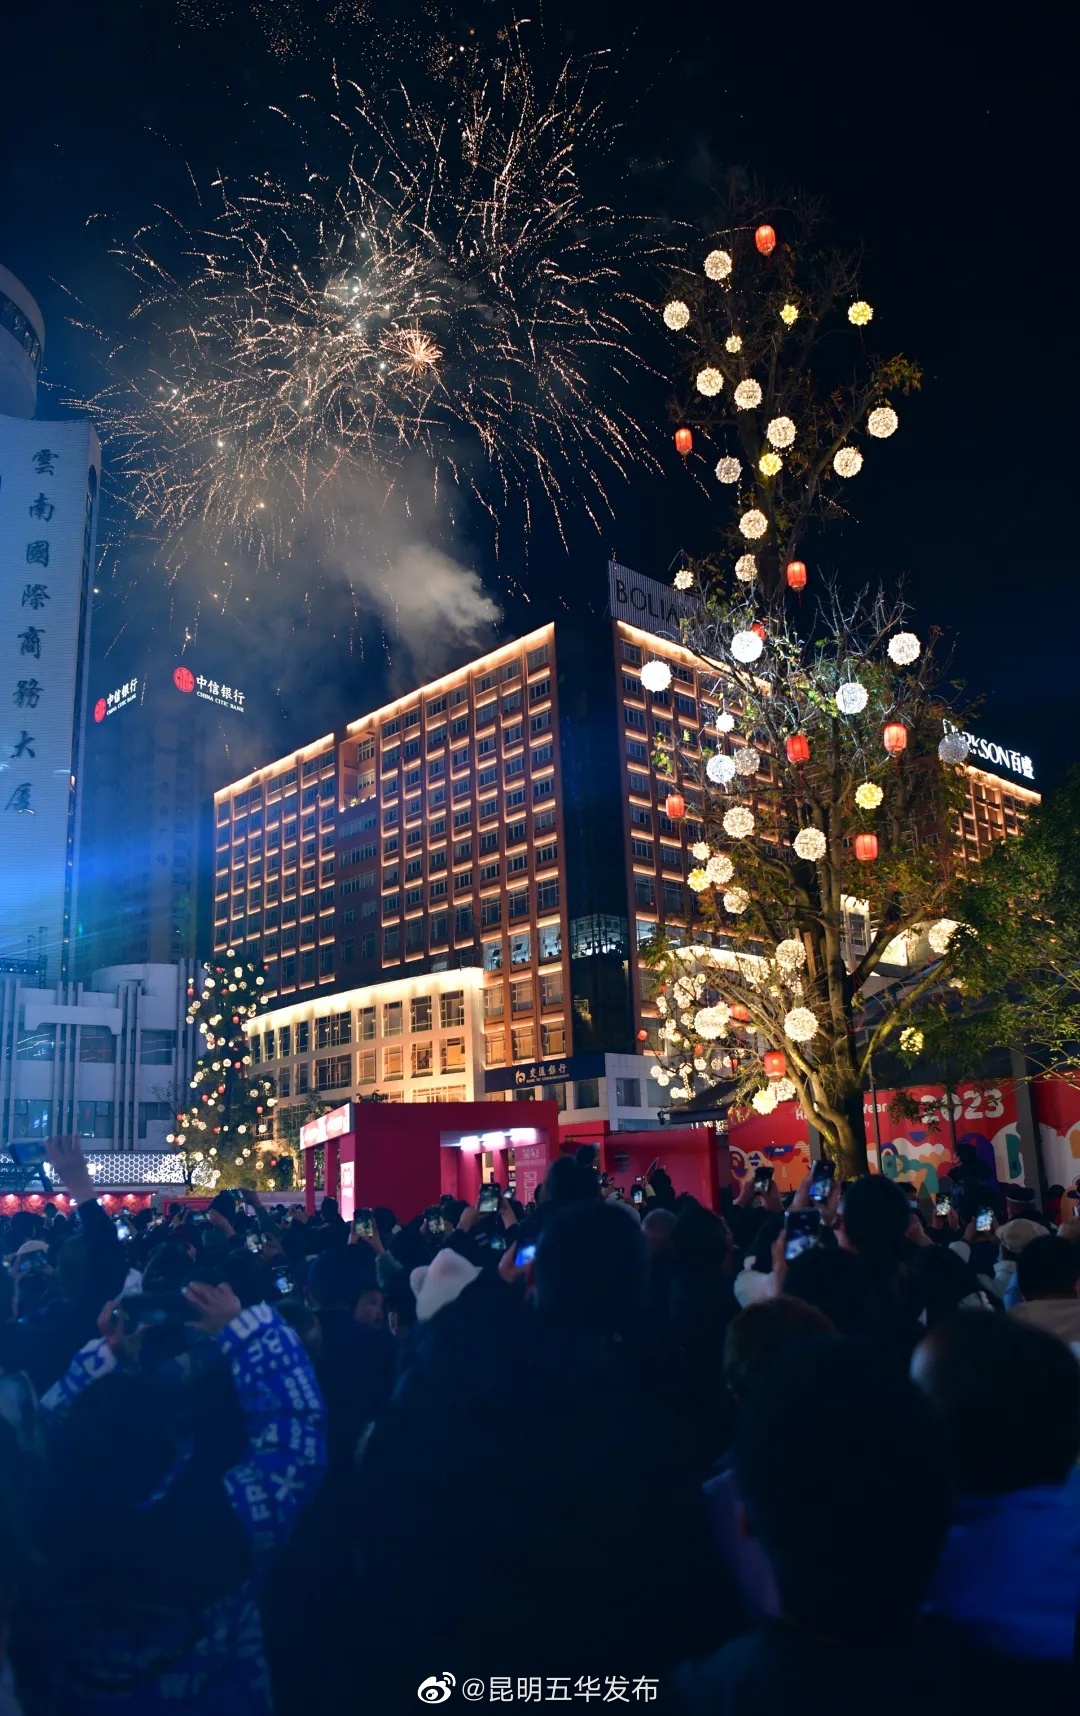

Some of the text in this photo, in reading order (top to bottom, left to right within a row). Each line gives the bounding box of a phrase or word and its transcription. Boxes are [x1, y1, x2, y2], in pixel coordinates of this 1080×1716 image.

[106, 677, 138, 707] 中信银行
[196, 675, 246, 705] 中信银行
[196, 691, 214, 702] CHINA
[920, 1089, 1005, 1124] 2023
